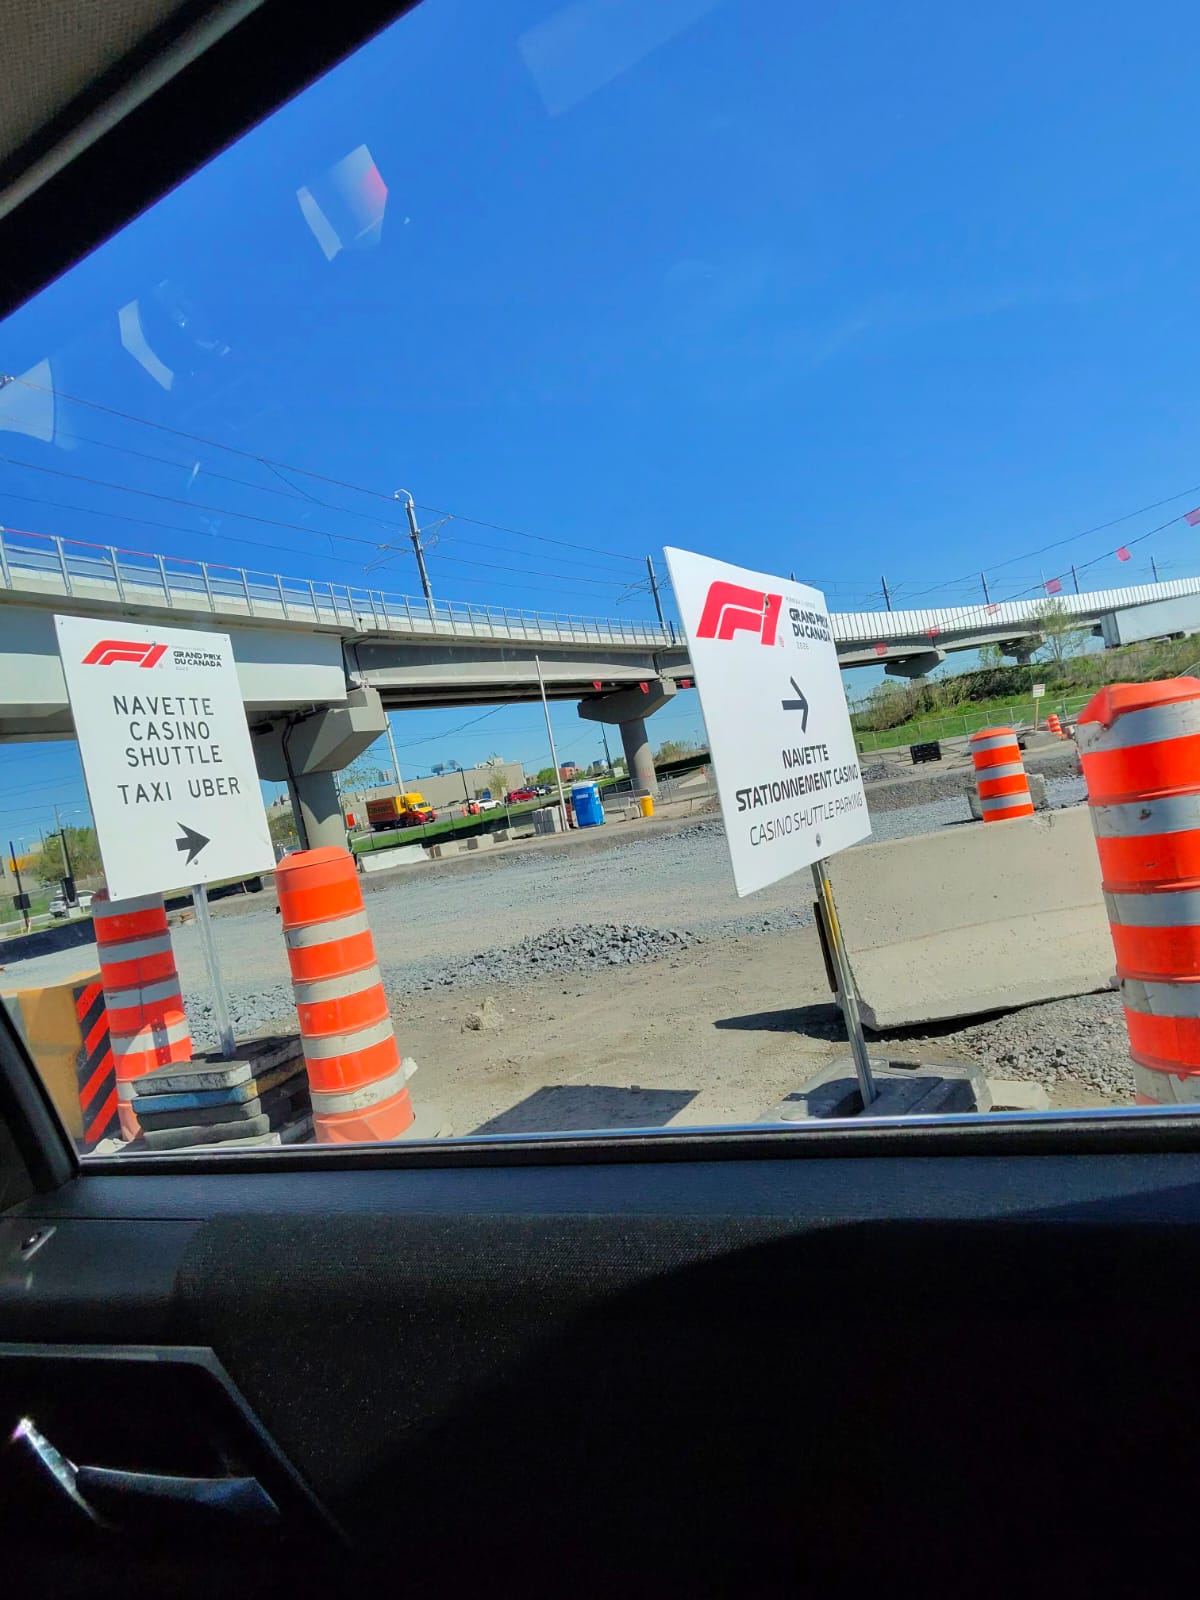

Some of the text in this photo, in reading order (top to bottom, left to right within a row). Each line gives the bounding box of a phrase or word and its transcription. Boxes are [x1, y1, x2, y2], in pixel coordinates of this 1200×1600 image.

[696, 581, 783, 646] F1
[789, 608, 815, 625] GRAND
[791, 623, 832, 643] DU CANADA
[81, 640, 169, 668] F1
[173, 650, 222, 660] GRAND PRIX
[175, 658, 222, 668] DU CANADA
[113, 695, 214, 716] NAVETTE
[130, 721, 210, 741] CASINO
[125, 745, 223, 767] SHUTTLE
[782, 744, 829, 769] NAVETTE
[117, 776, 241, 805] TAXI UBER
[736, 764, 859, 812] STATIONNEMENT CASINO
[750, 791, 863, 846] CASINO SHUTTLE PARKING
